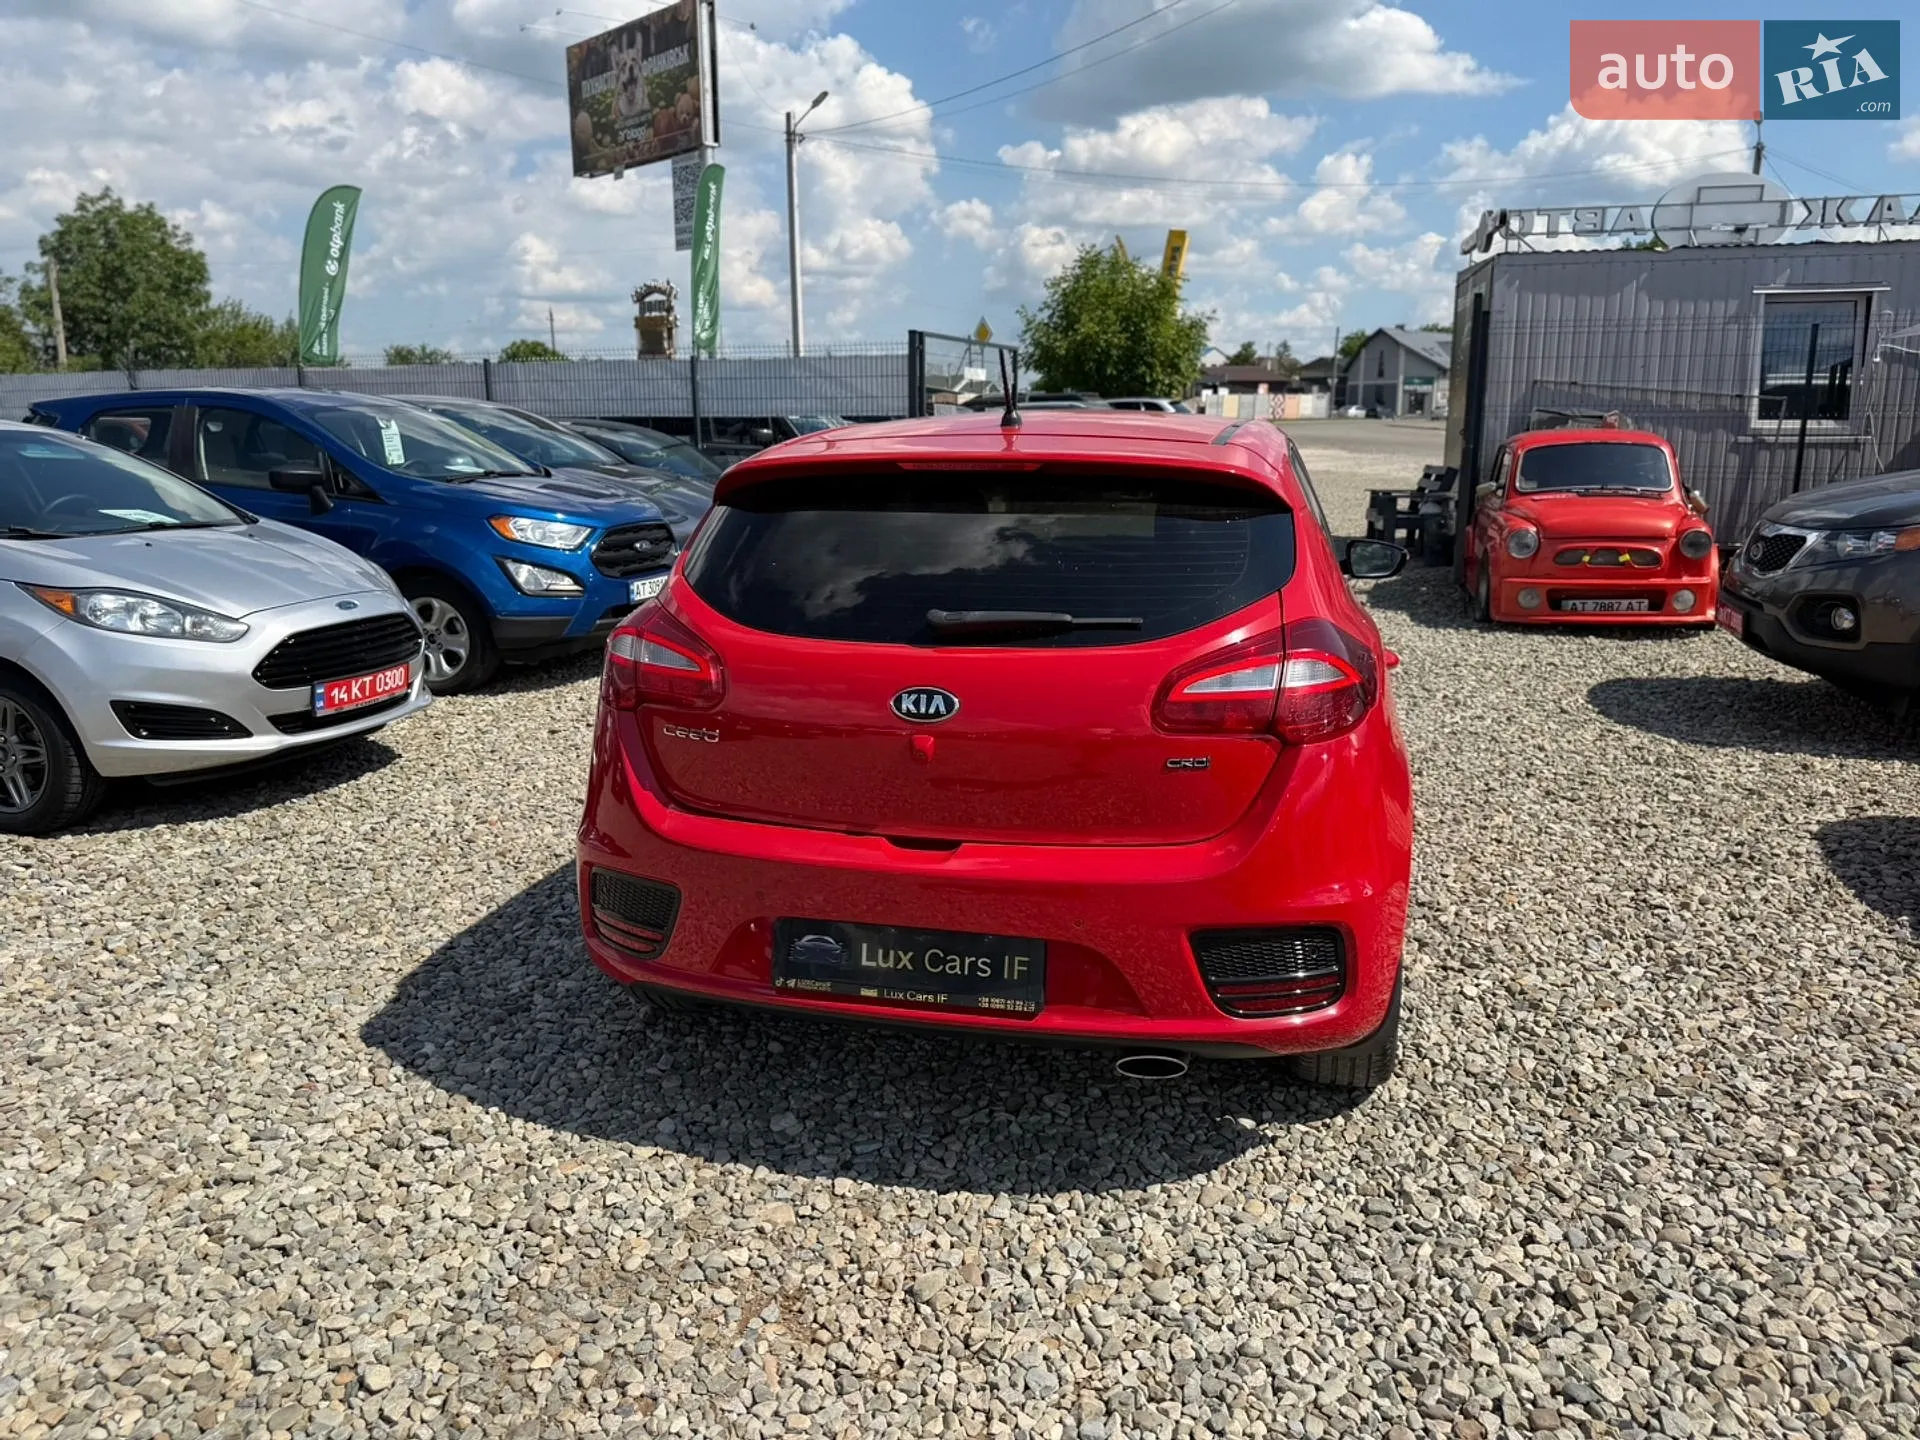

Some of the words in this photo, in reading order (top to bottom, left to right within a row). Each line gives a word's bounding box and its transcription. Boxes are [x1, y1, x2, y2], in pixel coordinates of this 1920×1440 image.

[329, 200, 345, 258] otpbank
[635, 582, 647, 598] AT
[331, 685, 348, 704] 14
[351, 676, 374, 700] KT
[375, 667, 405, 693] 0300
[901, 694, 947, 714] KIA
[861, 943, 914, 970] Lux
[924, 949, 992, 977] Cars
[1004, 955, 1030, 980] IF
[884, 988, 904, 1000] Lux
[906, 990, 935, 1003] Cars
[937, 993, 949, 1004] IF
